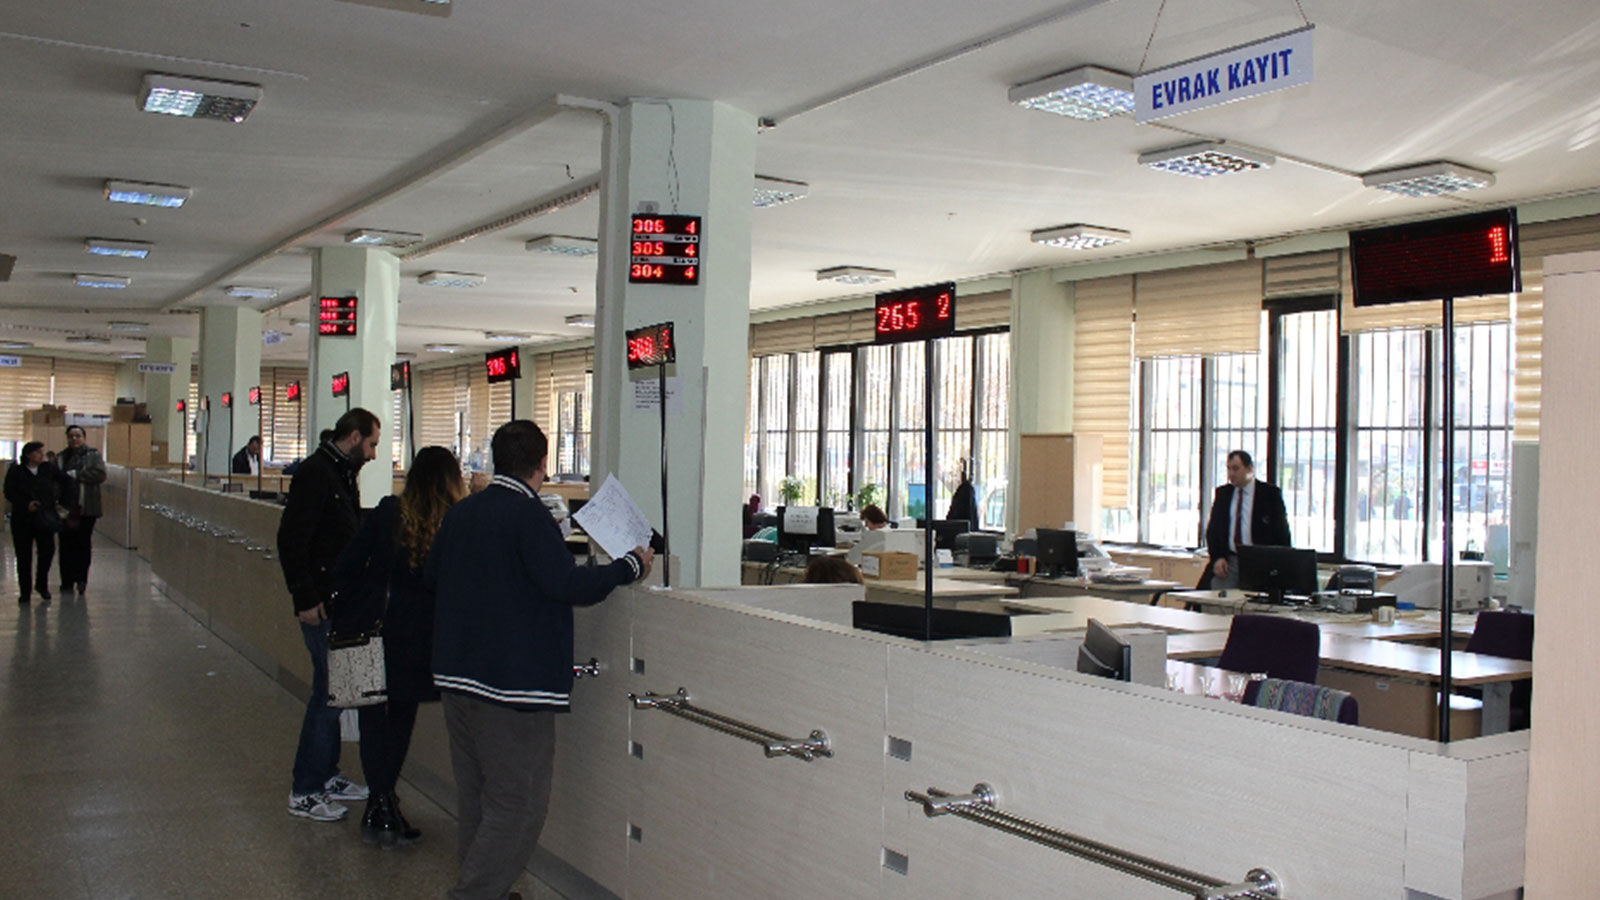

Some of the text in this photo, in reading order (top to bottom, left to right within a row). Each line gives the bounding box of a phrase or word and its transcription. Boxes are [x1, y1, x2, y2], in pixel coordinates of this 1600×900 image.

[1152, 48, 1293, 110] EVRAK KAYIT
[632, 219, 696, 235] 306 4
[632, 241, 696, 257] 305 4
[1488, 226, 1508, 263] 1
[631, 264, 696, 280] 304 4
[877, 292, 950, 332] 265 2
